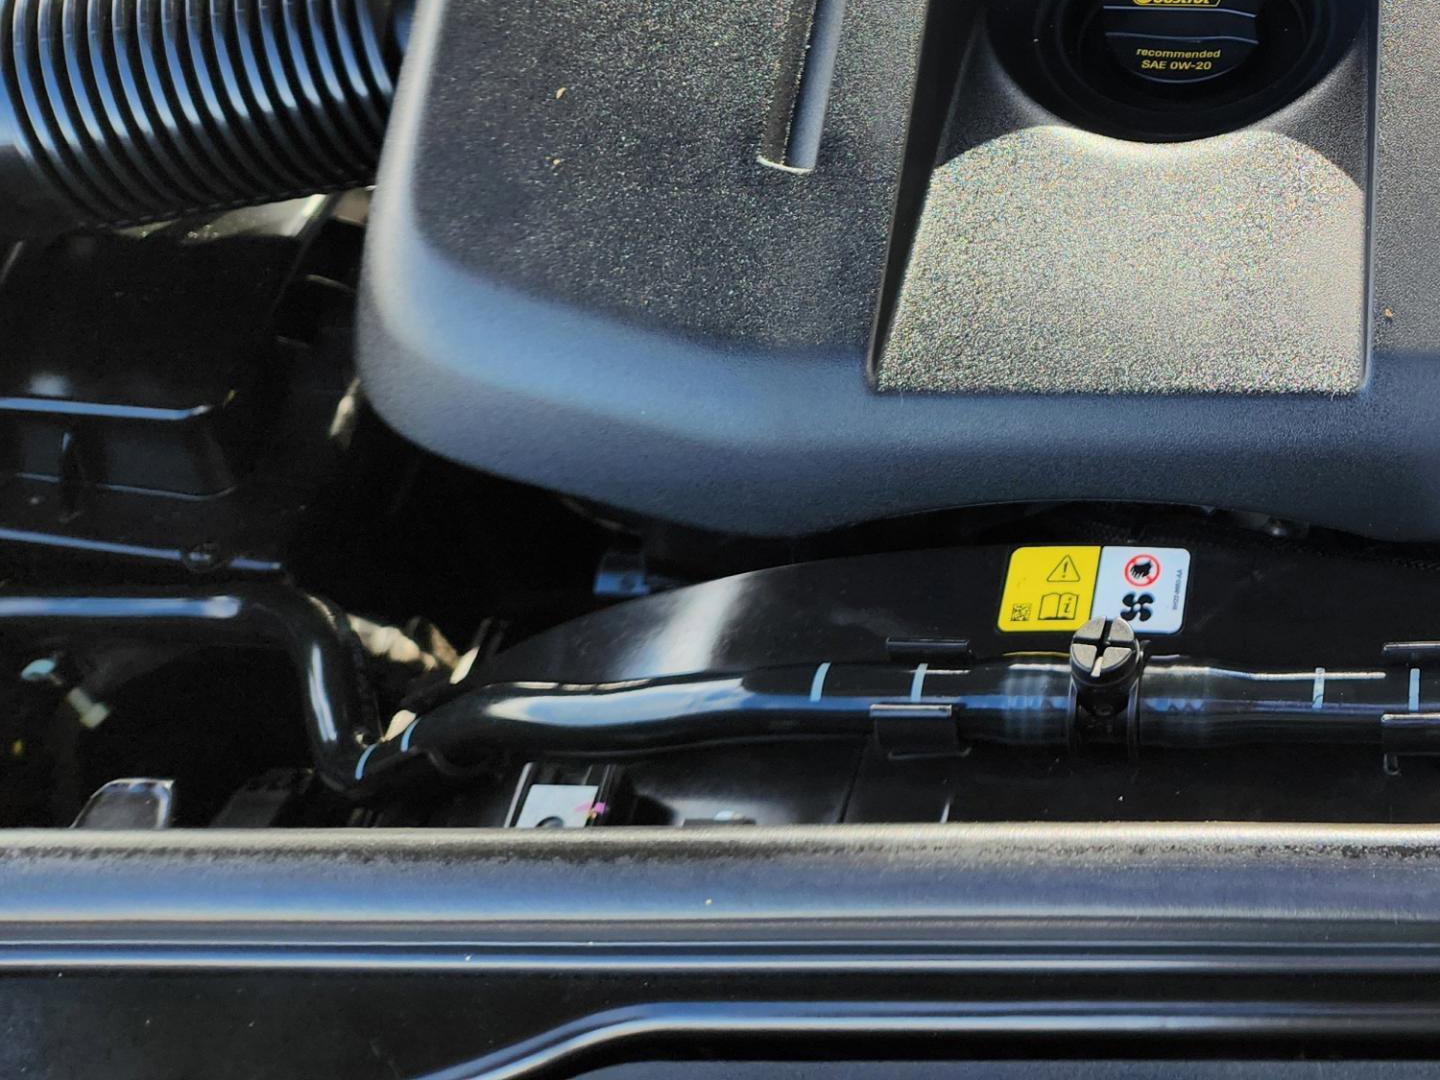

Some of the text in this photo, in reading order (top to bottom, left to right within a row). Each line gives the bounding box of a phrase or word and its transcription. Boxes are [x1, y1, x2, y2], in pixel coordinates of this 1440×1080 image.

[1136, 47, 1222, 59] recommended
[1141, 59, 1213, 71] SAE 0W-20
